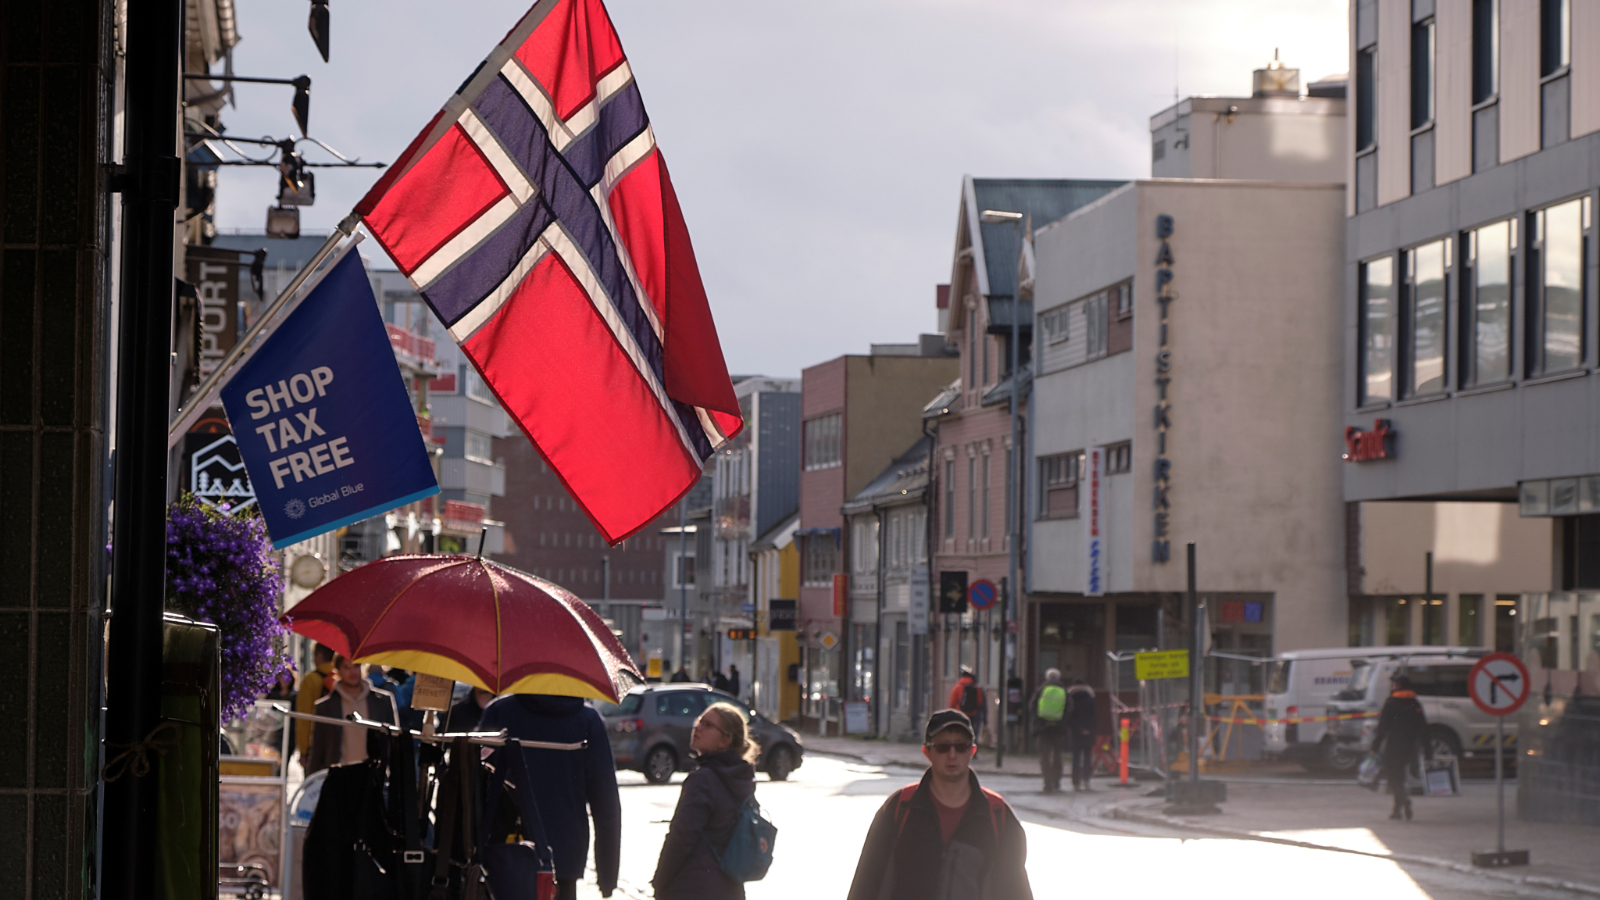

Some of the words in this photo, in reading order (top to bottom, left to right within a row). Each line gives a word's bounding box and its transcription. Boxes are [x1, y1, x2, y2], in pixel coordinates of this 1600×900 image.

[245, 366, 334, 420] SHOP
[1152, 214, 1175, 564] BAPTISTKIRKEN
[255, 407, 327, 453] TAX
[269, 436, 355, 490] FREE
[308, 489, 339, 509] Global
[340, 482, 364, 498] Blue
